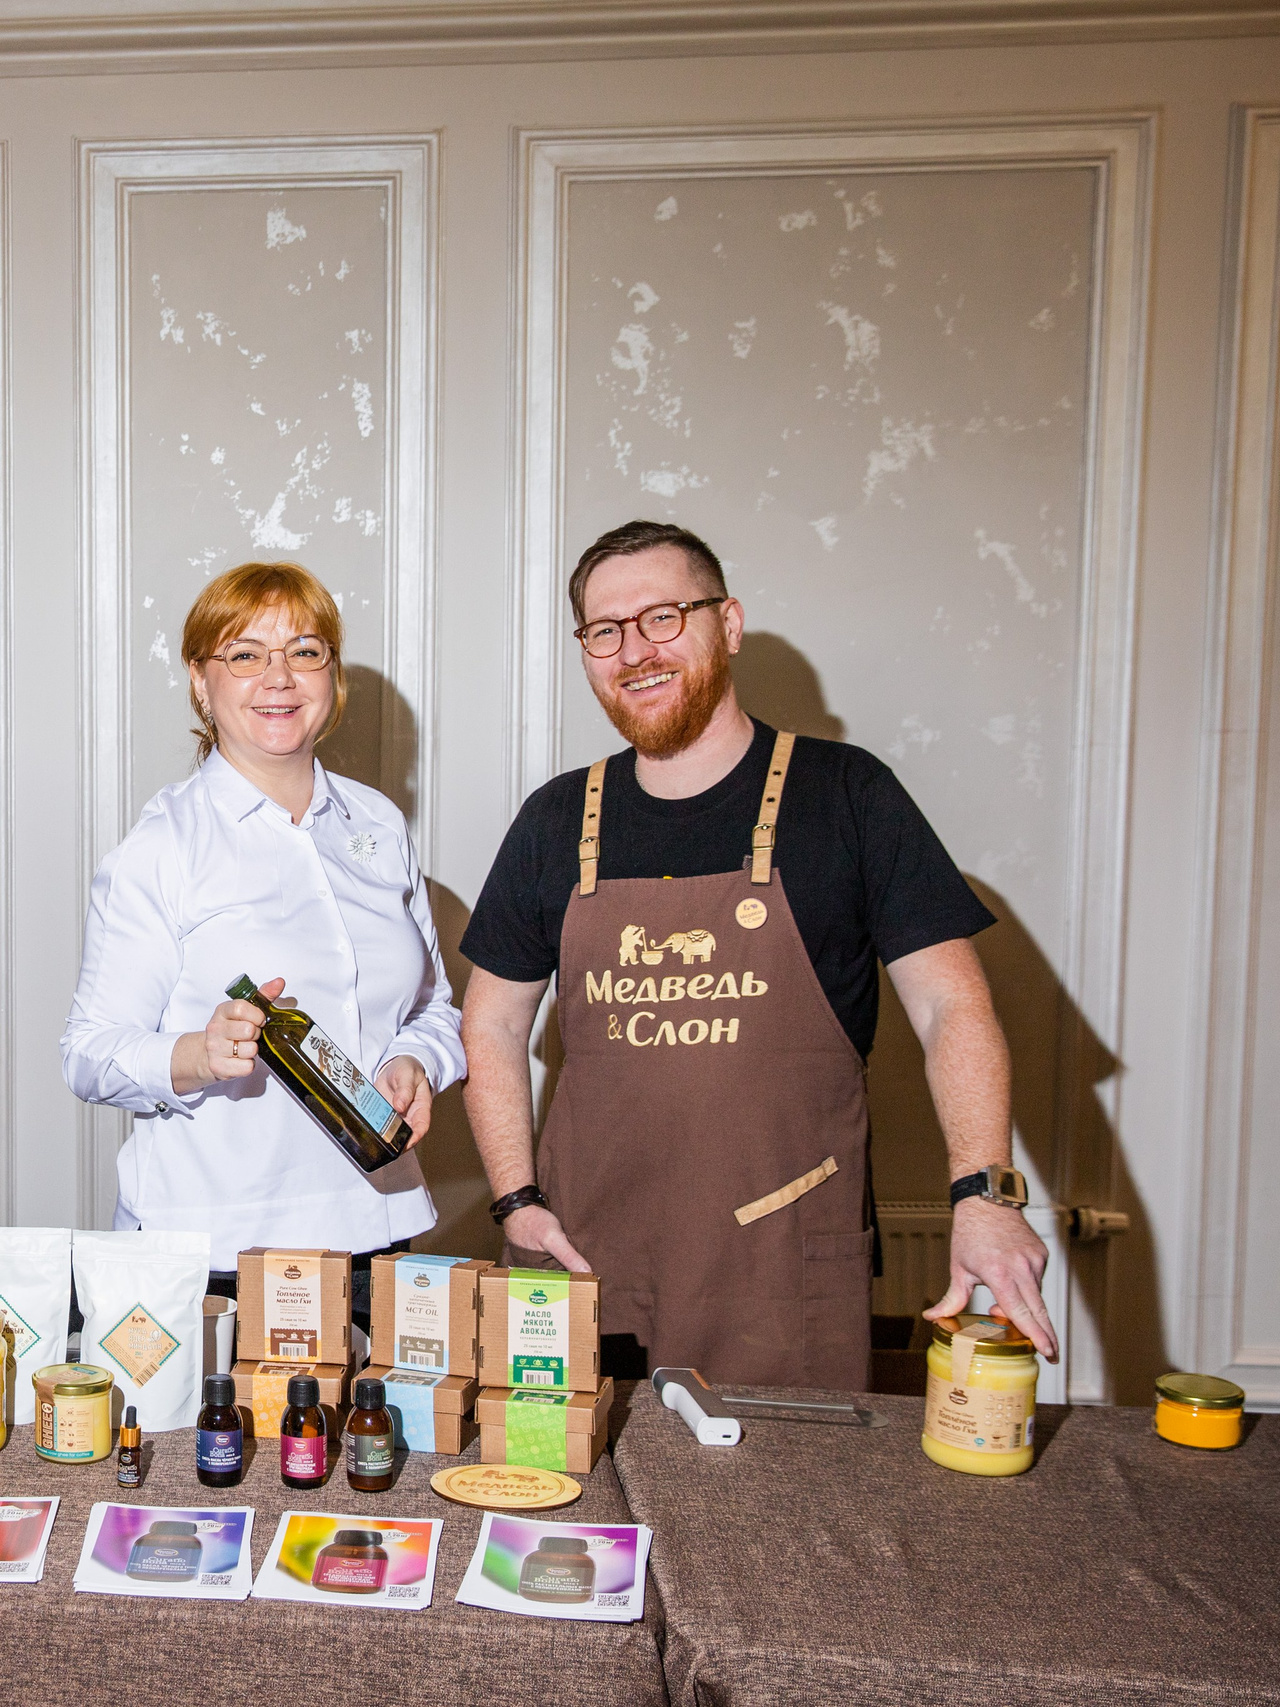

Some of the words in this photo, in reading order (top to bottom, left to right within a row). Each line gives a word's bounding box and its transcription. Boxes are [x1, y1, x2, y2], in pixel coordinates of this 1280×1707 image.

[586, 969, 769, 1005] Медведь
[331, 1050, 343, 1086] MCT
[342, 1063, 353, 1088] OIL
[276, 1290, 310, 1298] Топлёное
[405, 1306, 422, 1314] MCT
[425, 1308, 439, 1316] OIL
[520, 1328, 557, 1336] АВОКАДО
[42, 1412, 53, 1449] GHEE
[458, 1480, 553, 1491] Медведь
[483, 1488, 540, 1497] Слон
